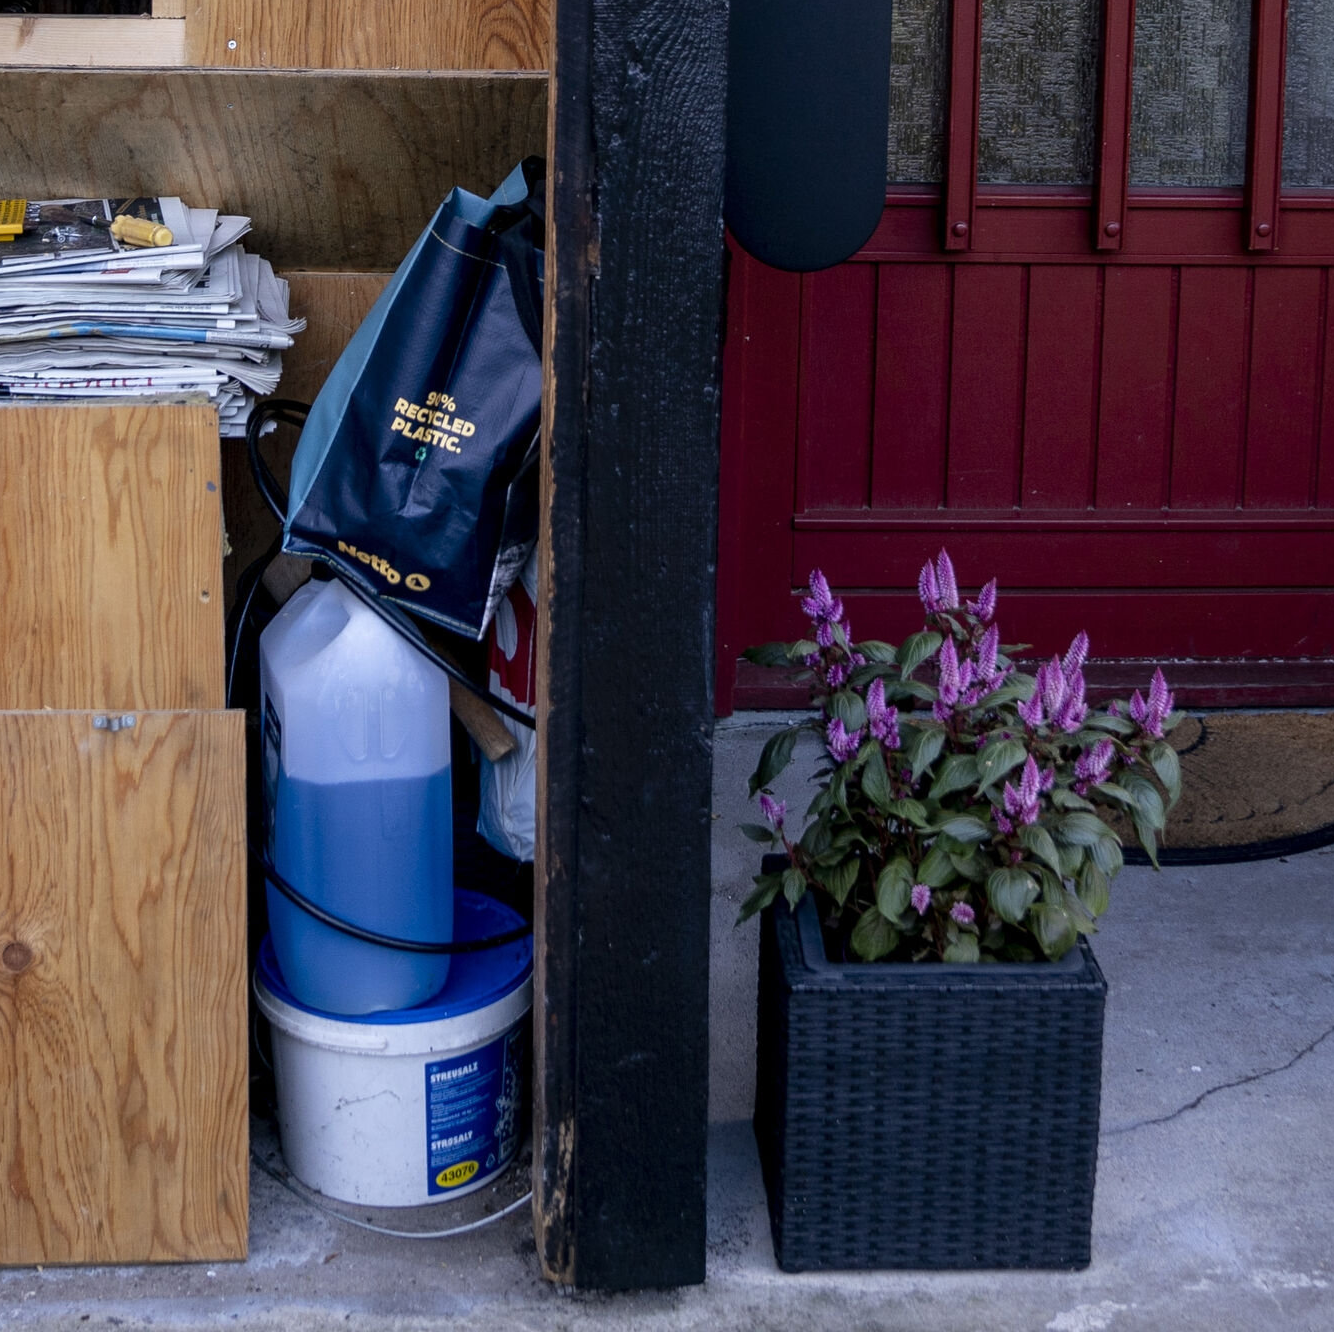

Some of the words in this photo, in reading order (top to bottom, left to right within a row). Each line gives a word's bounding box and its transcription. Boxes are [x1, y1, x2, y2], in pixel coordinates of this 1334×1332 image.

[390, 416, 462, 455] PLASTIC.
[394, 397, 476, 438] RECYCLED
[338, 540, 401, 585] Netto
[430, 1060, 478, 1085] STREUSALZ
